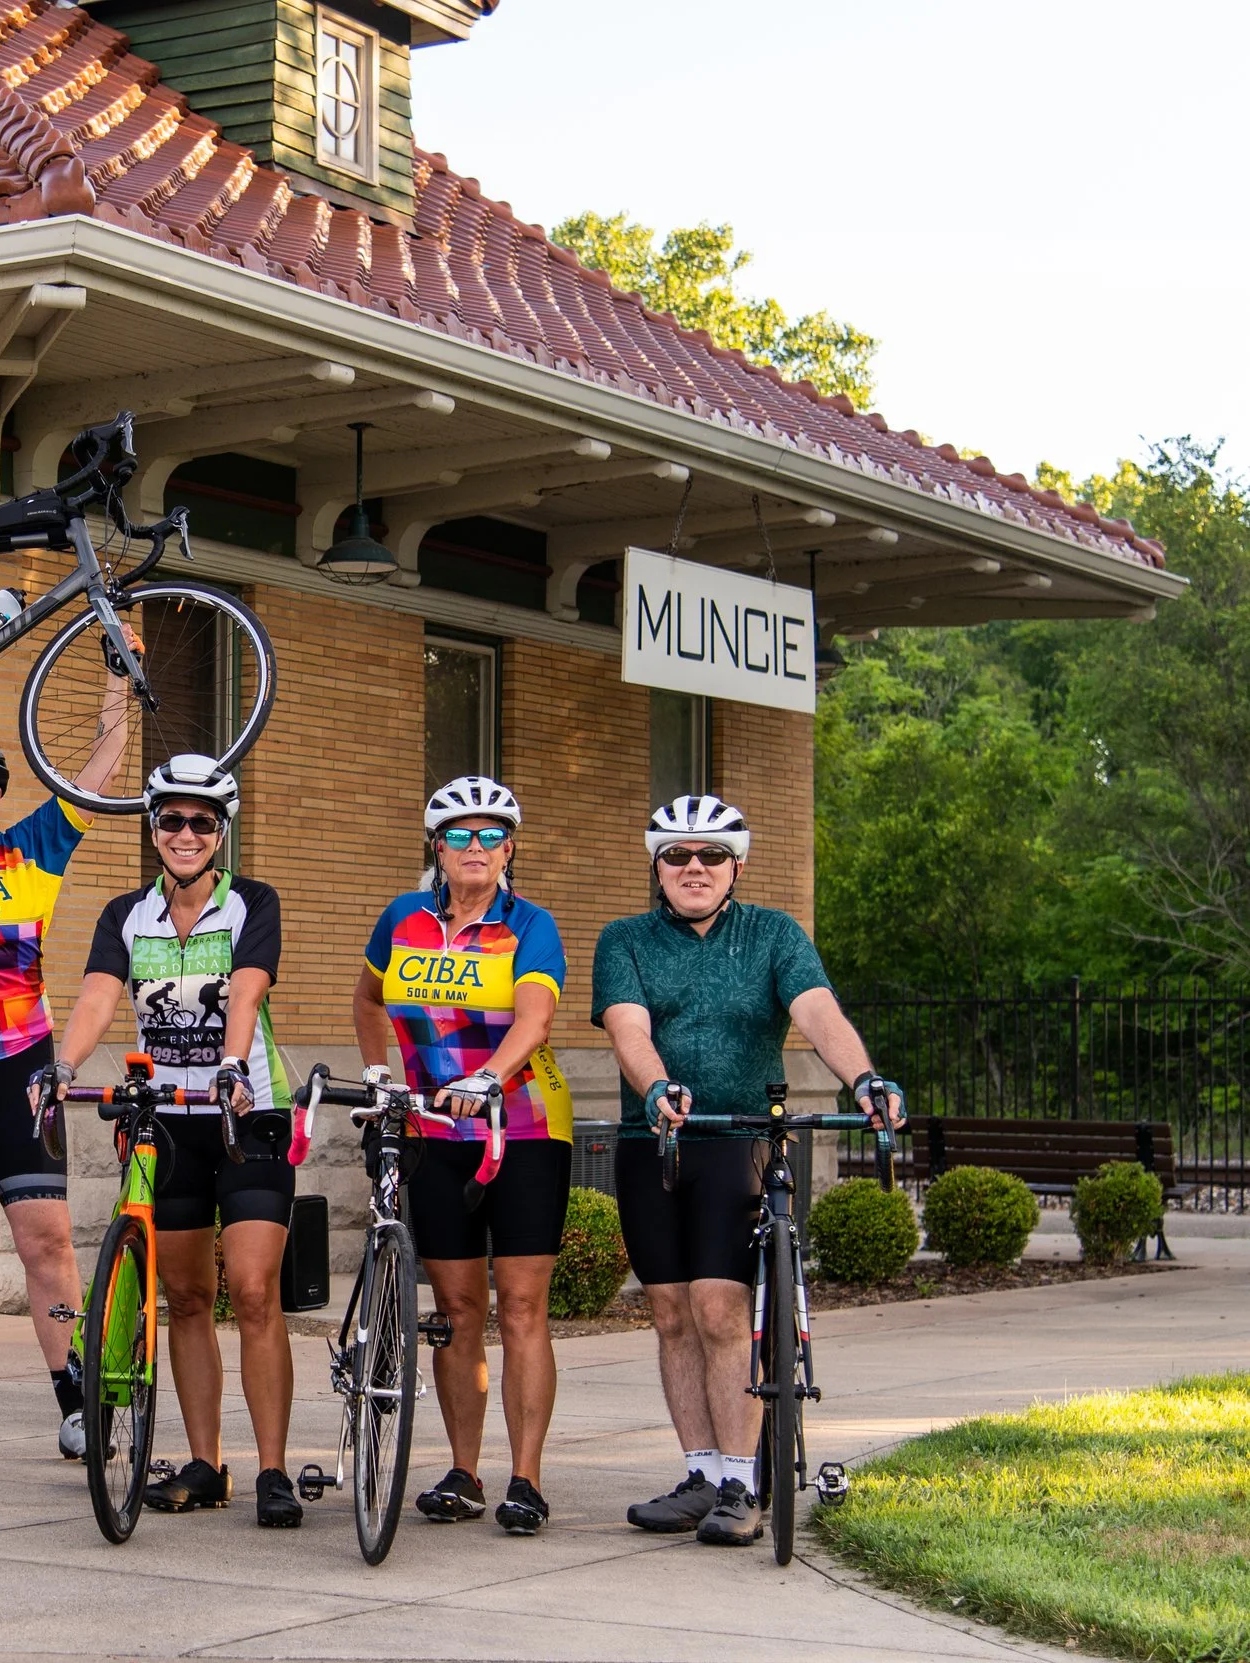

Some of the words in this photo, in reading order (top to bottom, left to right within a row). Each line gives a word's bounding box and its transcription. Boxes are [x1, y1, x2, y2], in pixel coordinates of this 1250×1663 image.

[638, 584, 806, 681] MUNCIE
[133, 941, 168, 963] 25
[133, 959, 231, 975] CARDINAL
[398, 955, 484, 987] CIBA
[407, 987, 428, 999] 500
[445, 990, 468, 1002] MAY
[148, 1030, 224, 1045] ENWAY
[146, 1044, 225, 1064] 1993-201
